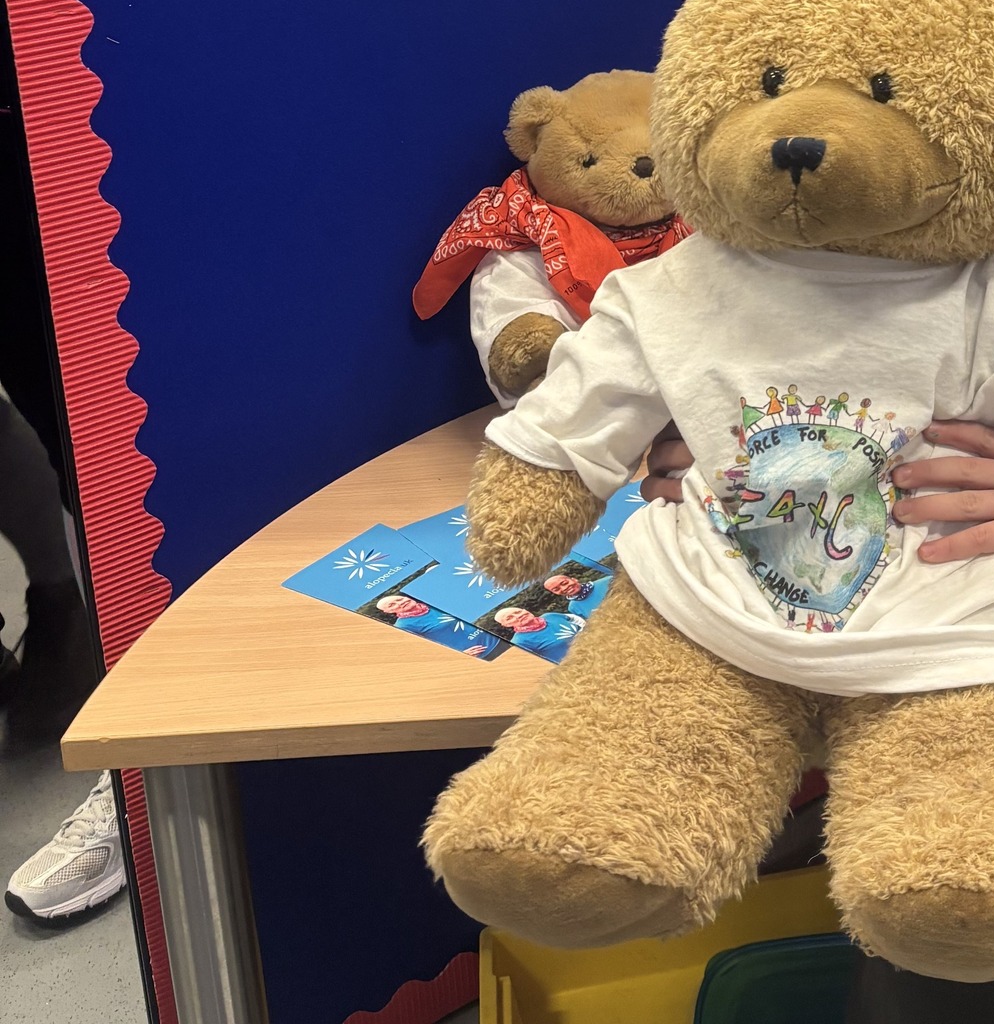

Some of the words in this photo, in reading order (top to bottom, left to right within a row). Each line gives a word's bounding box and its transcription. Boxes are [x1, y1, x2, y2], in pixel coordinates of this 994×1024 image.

[750, 430, 781, 458] ORCE
[797, 426, 828, 442] FOR
[365, 564, 402, 590] alopecia
[401, 558, 414, 567] uk
[752, 561, 809, 604] CHANGE
